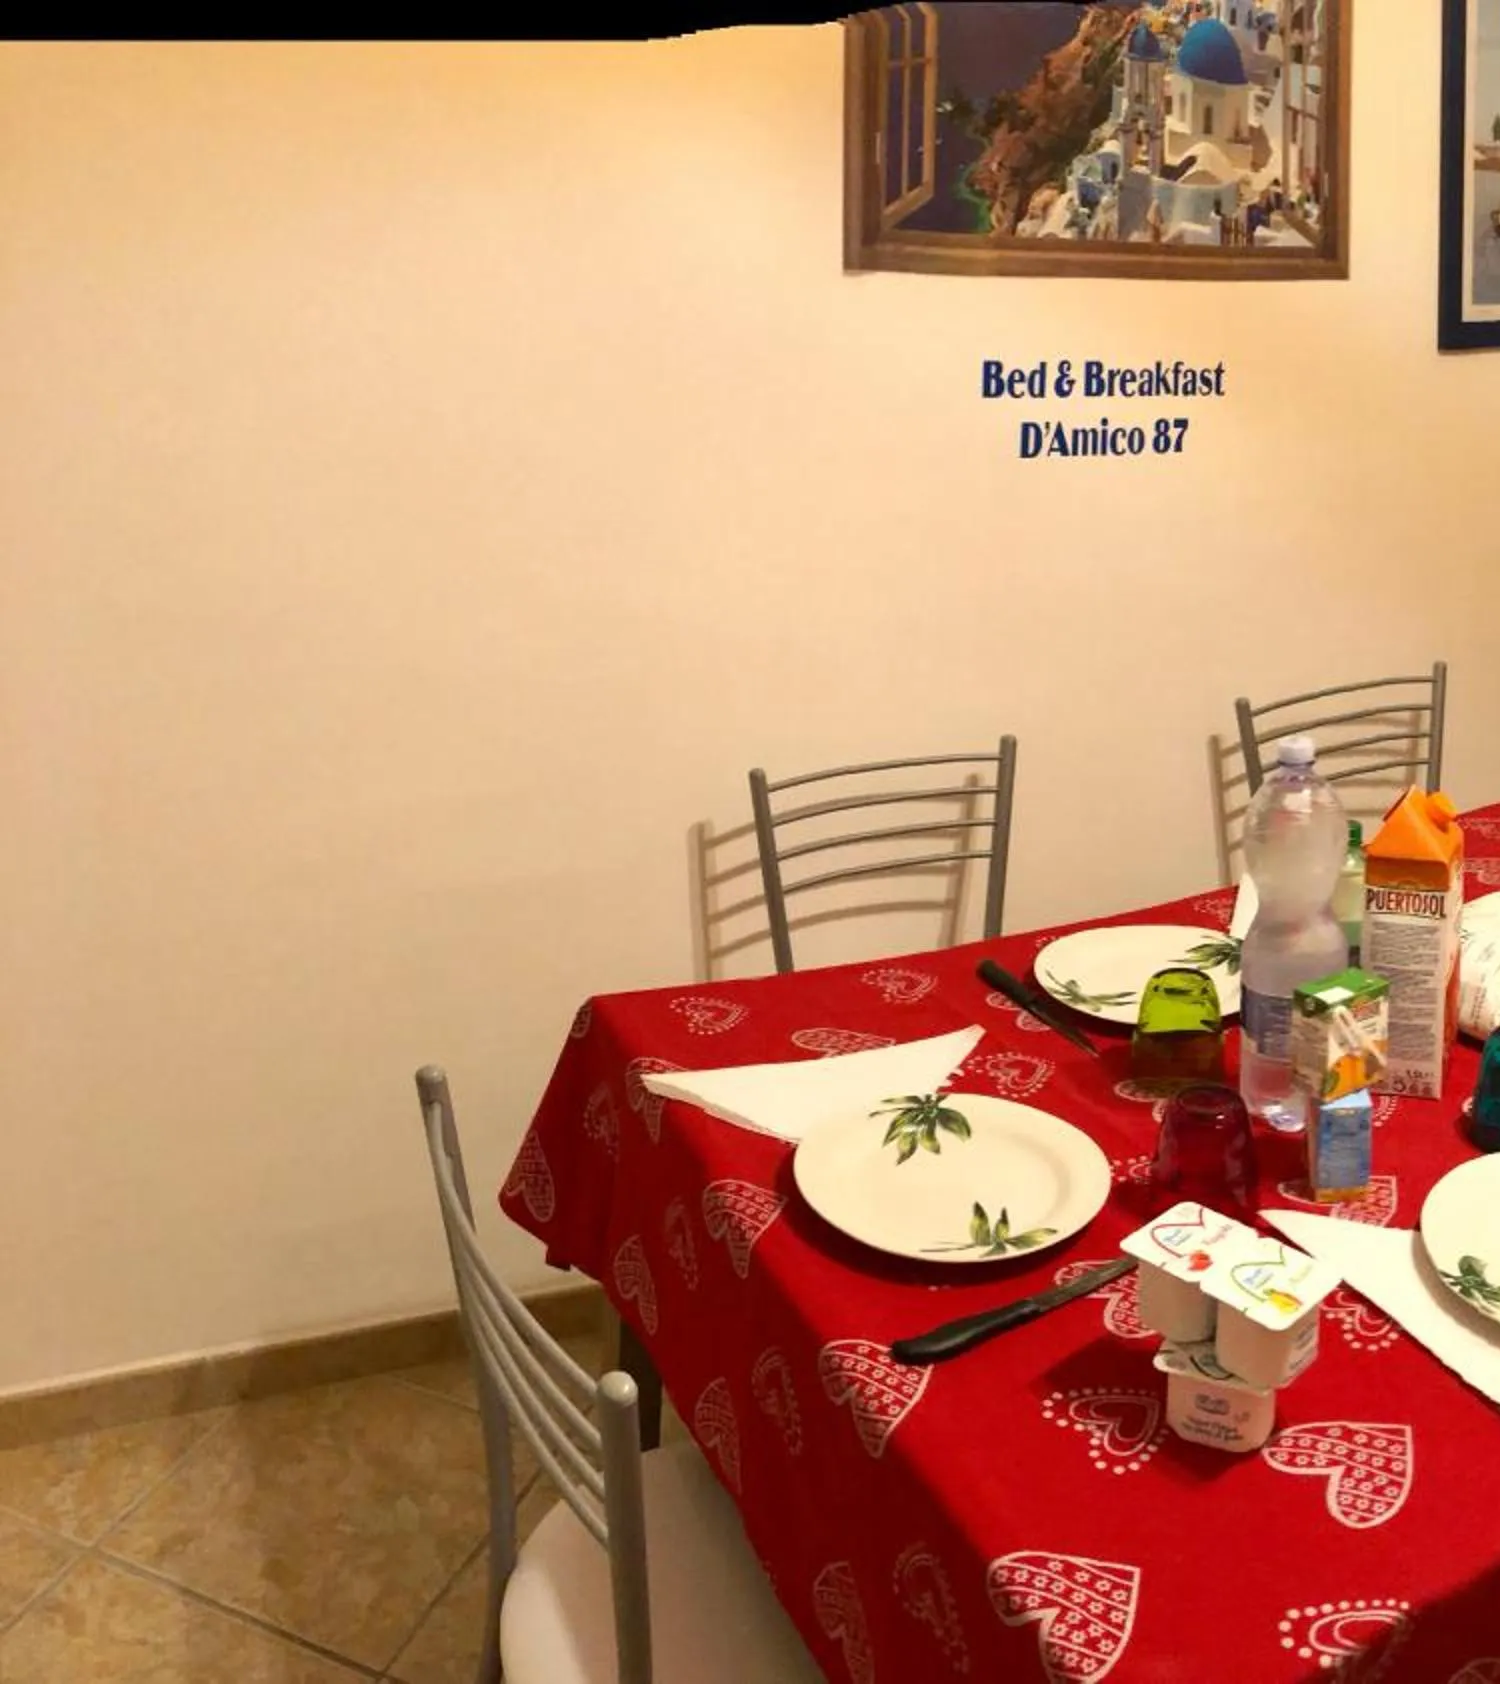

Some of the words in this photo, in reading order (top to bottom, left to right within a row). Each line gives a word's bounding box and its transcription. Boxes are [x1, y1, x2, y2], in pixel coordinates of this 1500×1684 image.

[981, 360, 1048, 399] Bed
[1054, 359, 1076, 398] &
[1083, 359, 1226, 397] Breakfast
[1019, 417, 1145, 459] D'Amico
[1152, 417, 1190, 454] 87
[1365, 887, 1447, 919] PUERTOSOL
